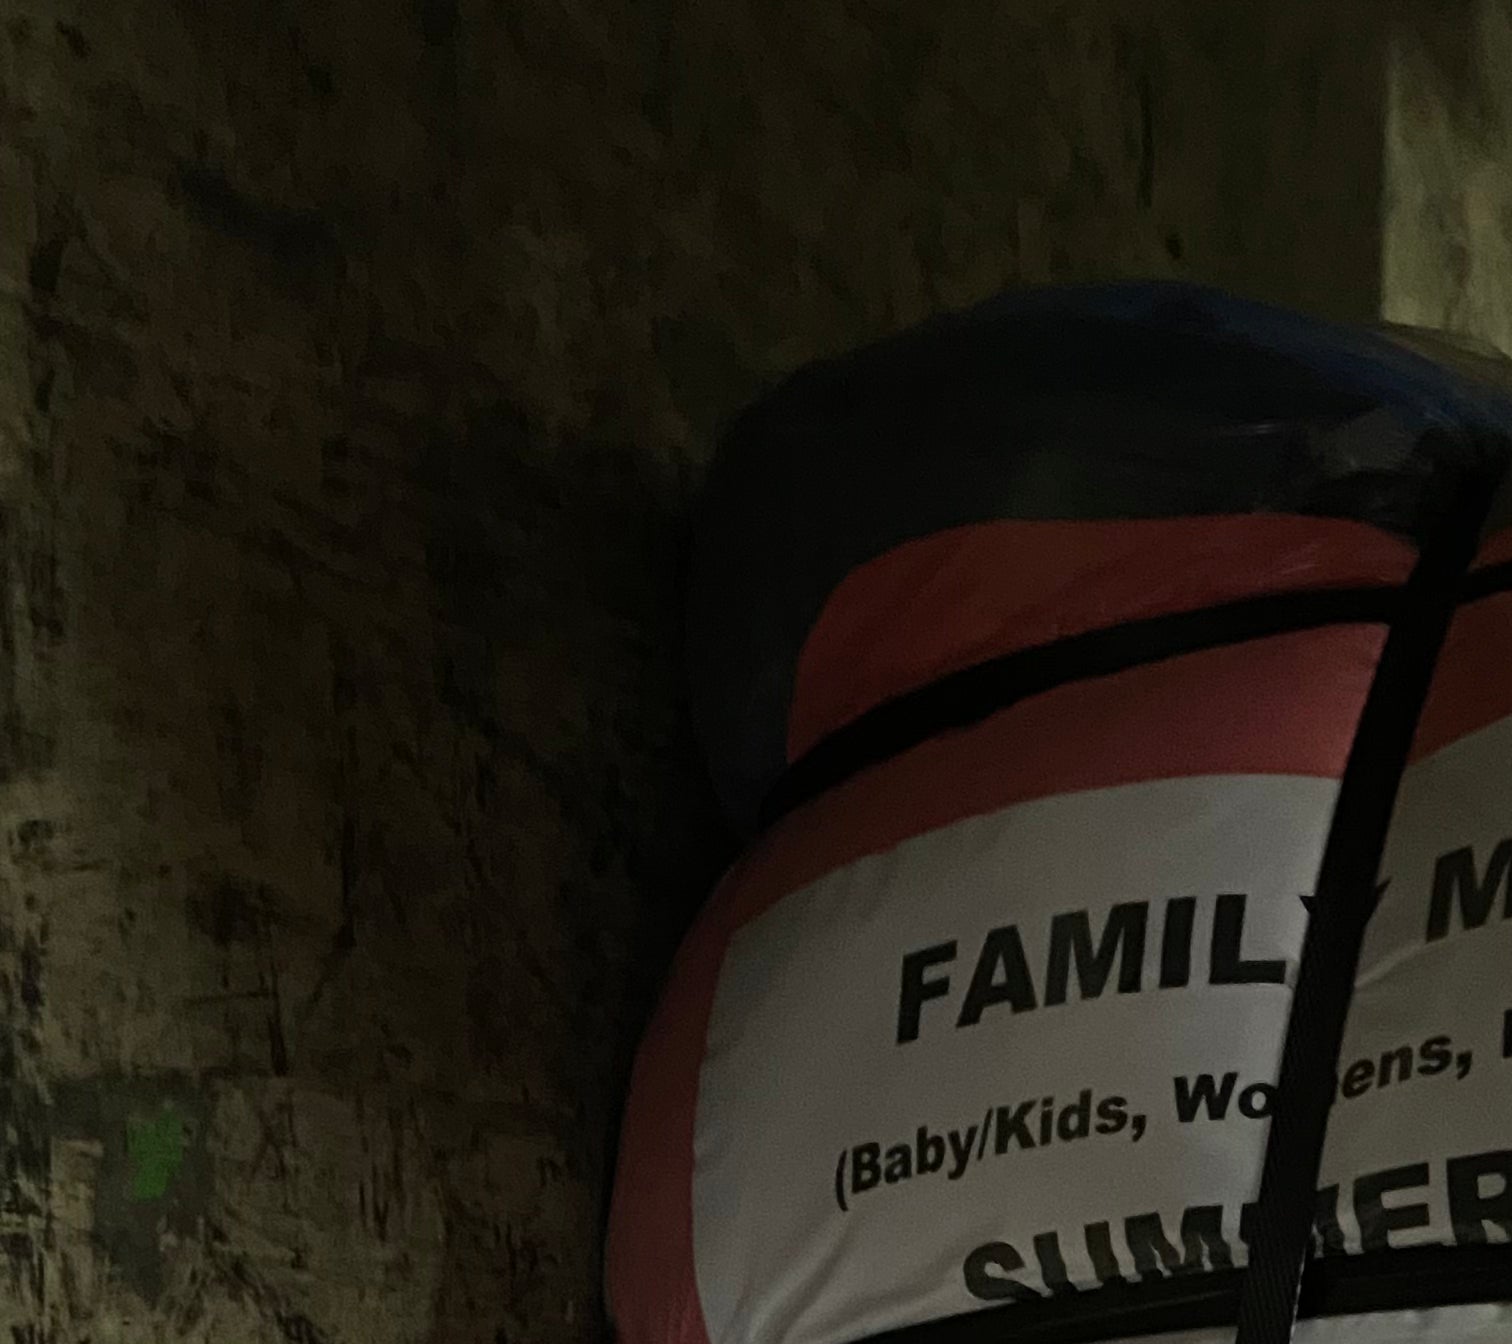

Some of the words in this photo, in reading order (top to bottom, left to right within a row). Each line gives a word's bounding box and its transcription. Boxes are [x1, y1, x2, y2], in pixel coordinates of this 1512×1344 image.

[897, 877, 1391, 1044] FAMIL
[835, 1088, 1147, 1211] (Baby/Kids,
[1174, 1035, 1472, 1123] Woens,
